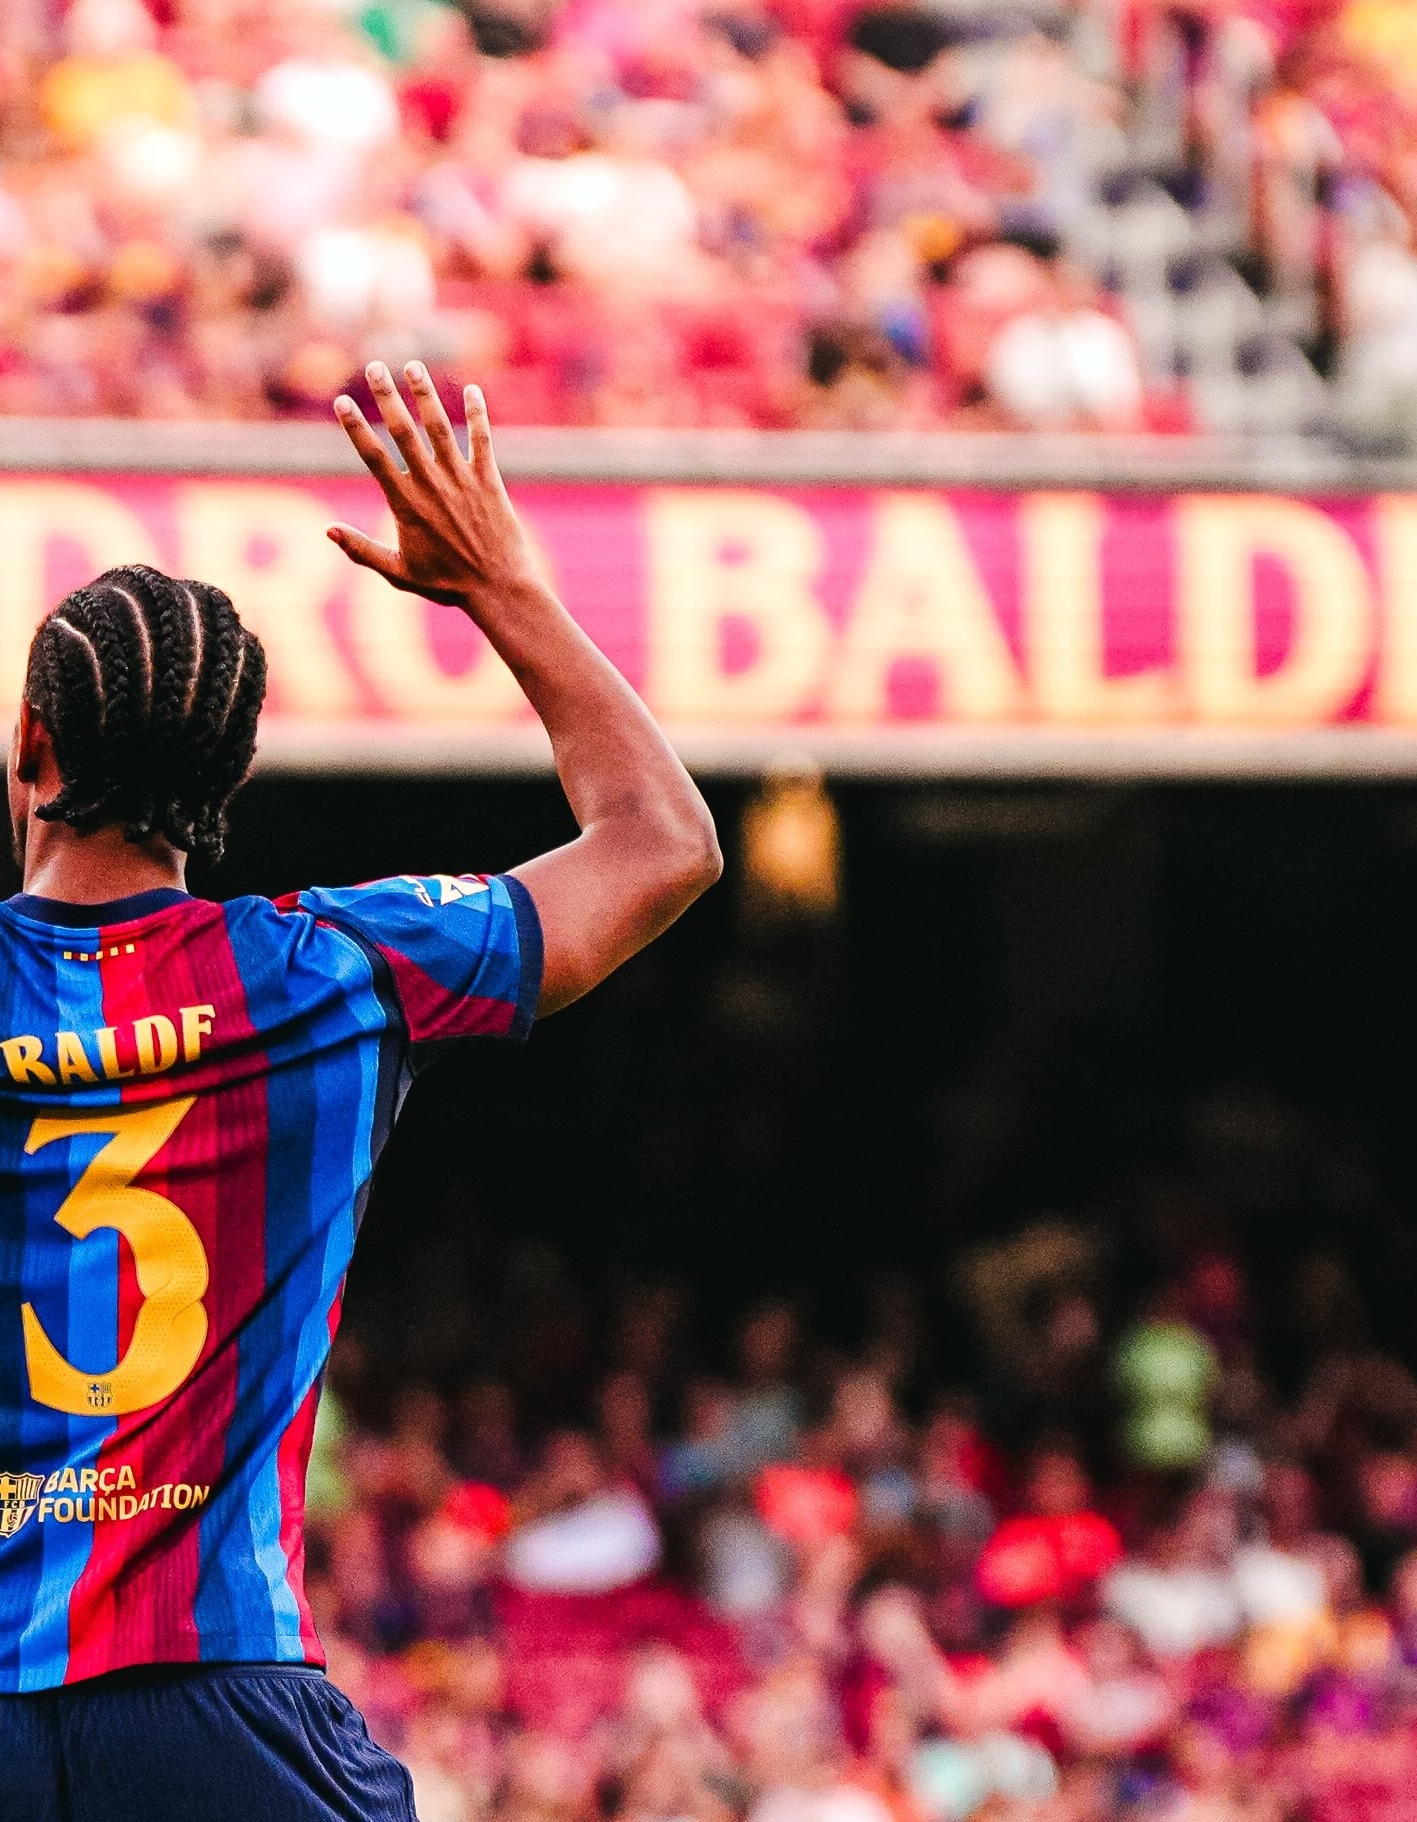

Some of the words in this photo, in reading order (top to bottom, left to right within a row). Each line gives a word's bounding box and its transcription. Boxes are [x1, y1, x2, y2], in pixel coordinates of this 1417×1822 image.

[643, 486, 1417, 724] BALD
[21, 1096, 209, 1416] 3
[38, 1484, 210, 1522] FOUNDATION
[43, 1465, 137, 1496] BARÇA
